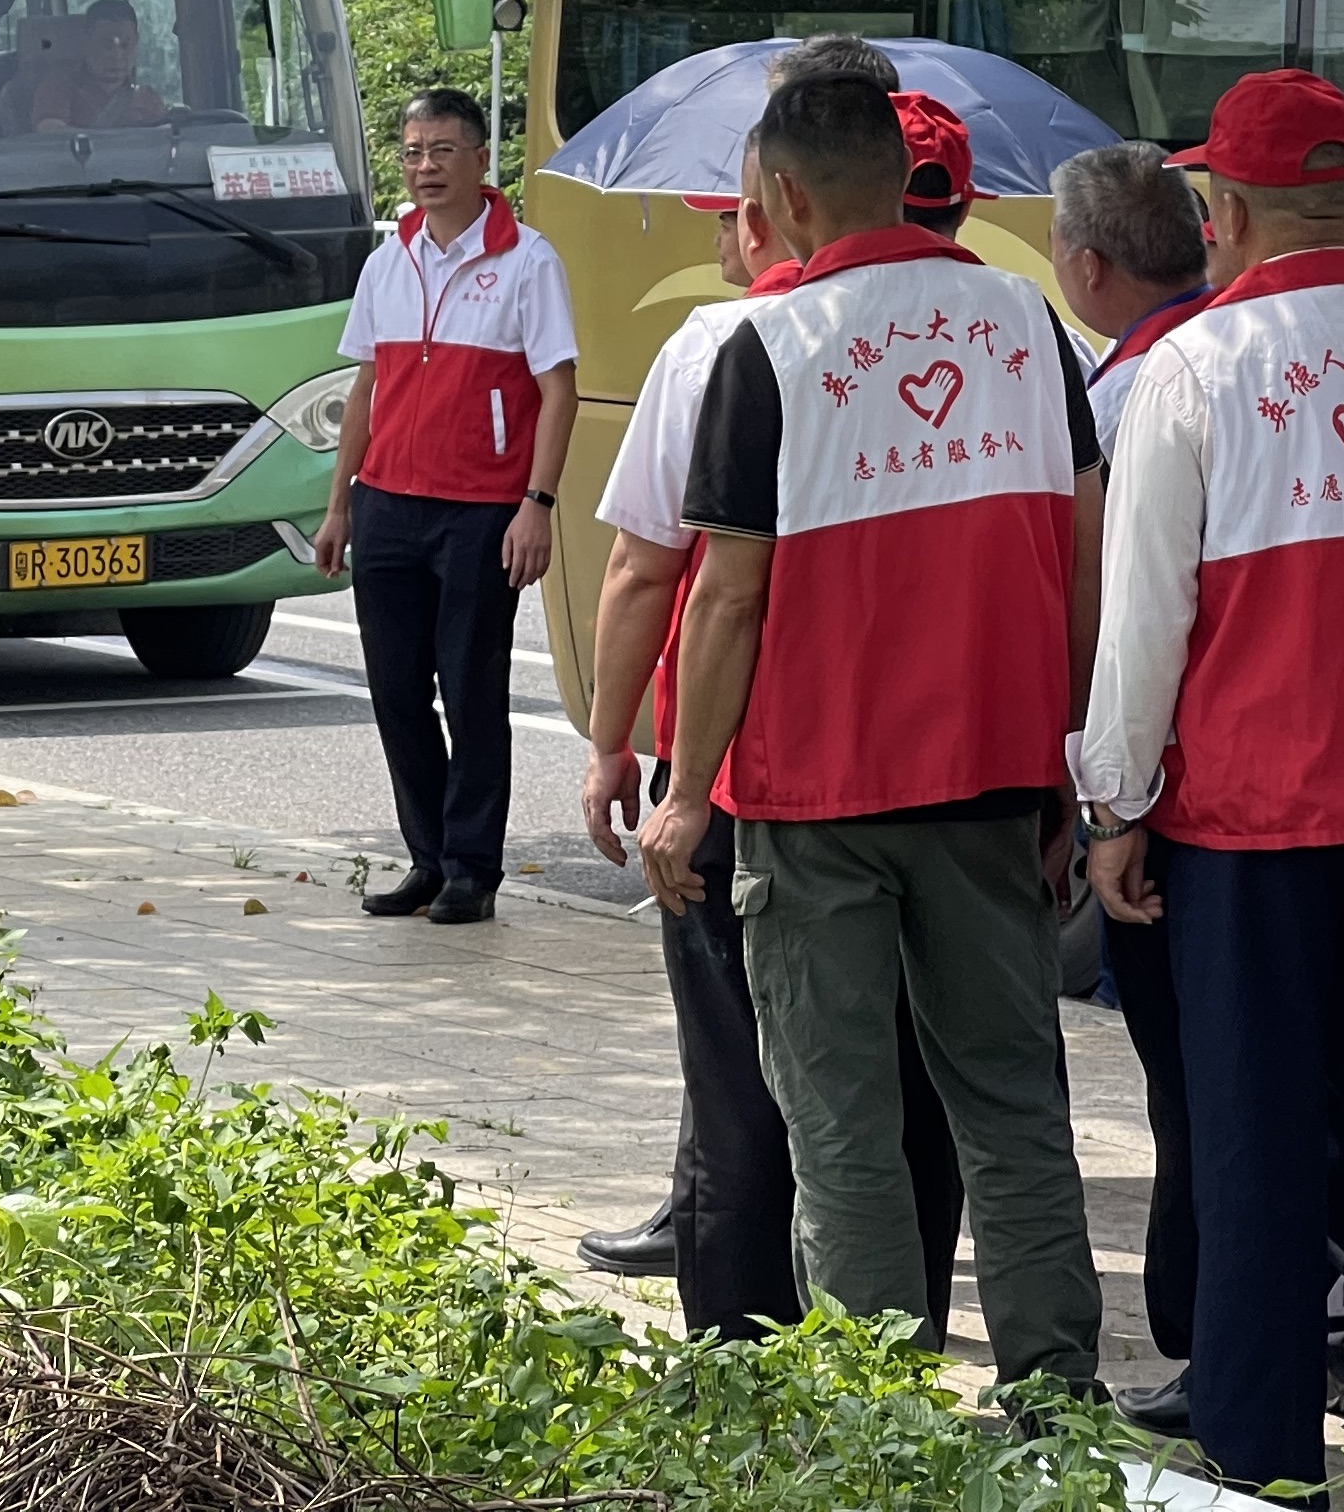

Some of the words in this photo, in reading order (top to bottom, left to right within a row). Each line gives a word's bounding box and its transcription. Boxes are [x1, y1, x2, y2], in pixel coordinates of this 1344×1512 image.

[822, 308, 1031, 408] 英德人大代表
[853, 430, 1025, 482] 志愿者服务队
